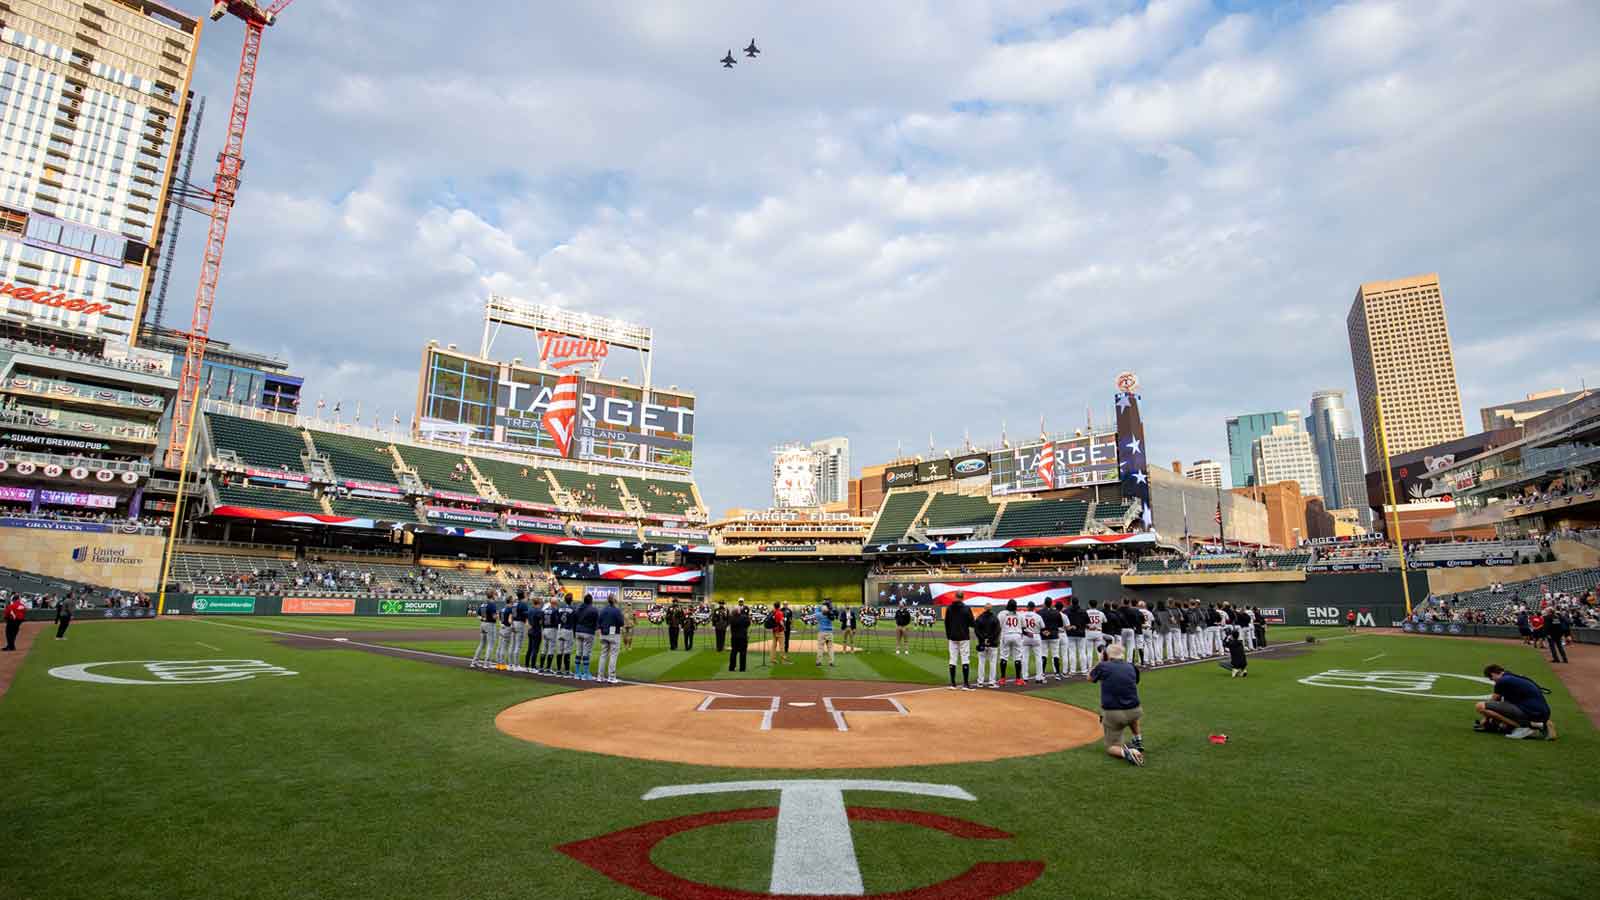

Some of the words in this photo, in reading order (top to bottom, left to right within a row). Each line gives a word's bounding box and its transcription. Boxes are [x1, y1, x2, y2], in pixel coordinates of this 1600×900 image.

[537, 331, 609, 362] Twins
[498, 379, 694, 435] TARGET
[582, 429, 627, 441] SLAND
[11, 434, 46, 445] SUMMIT
[46, 438, 85, 448] BREWING
[84, 441, 102, 450] PUB
[896, 471, 913, 480] pepsi
[443, 512, 472, 522] Treasure
[473, 515, 493, 523] Island
[744, 512, 797, 521] TARGET
[811, 512, 849, 521] FIELD
[93, 547, 125, 556] United
[92, 555, 144, 565] Healthcare
[1307, 607, 1340, 618] END
[1006, 617, 1018, 628] 40
[1025, 618, 1036, 628] 16
[1089, 615, 1100, 625] 35
